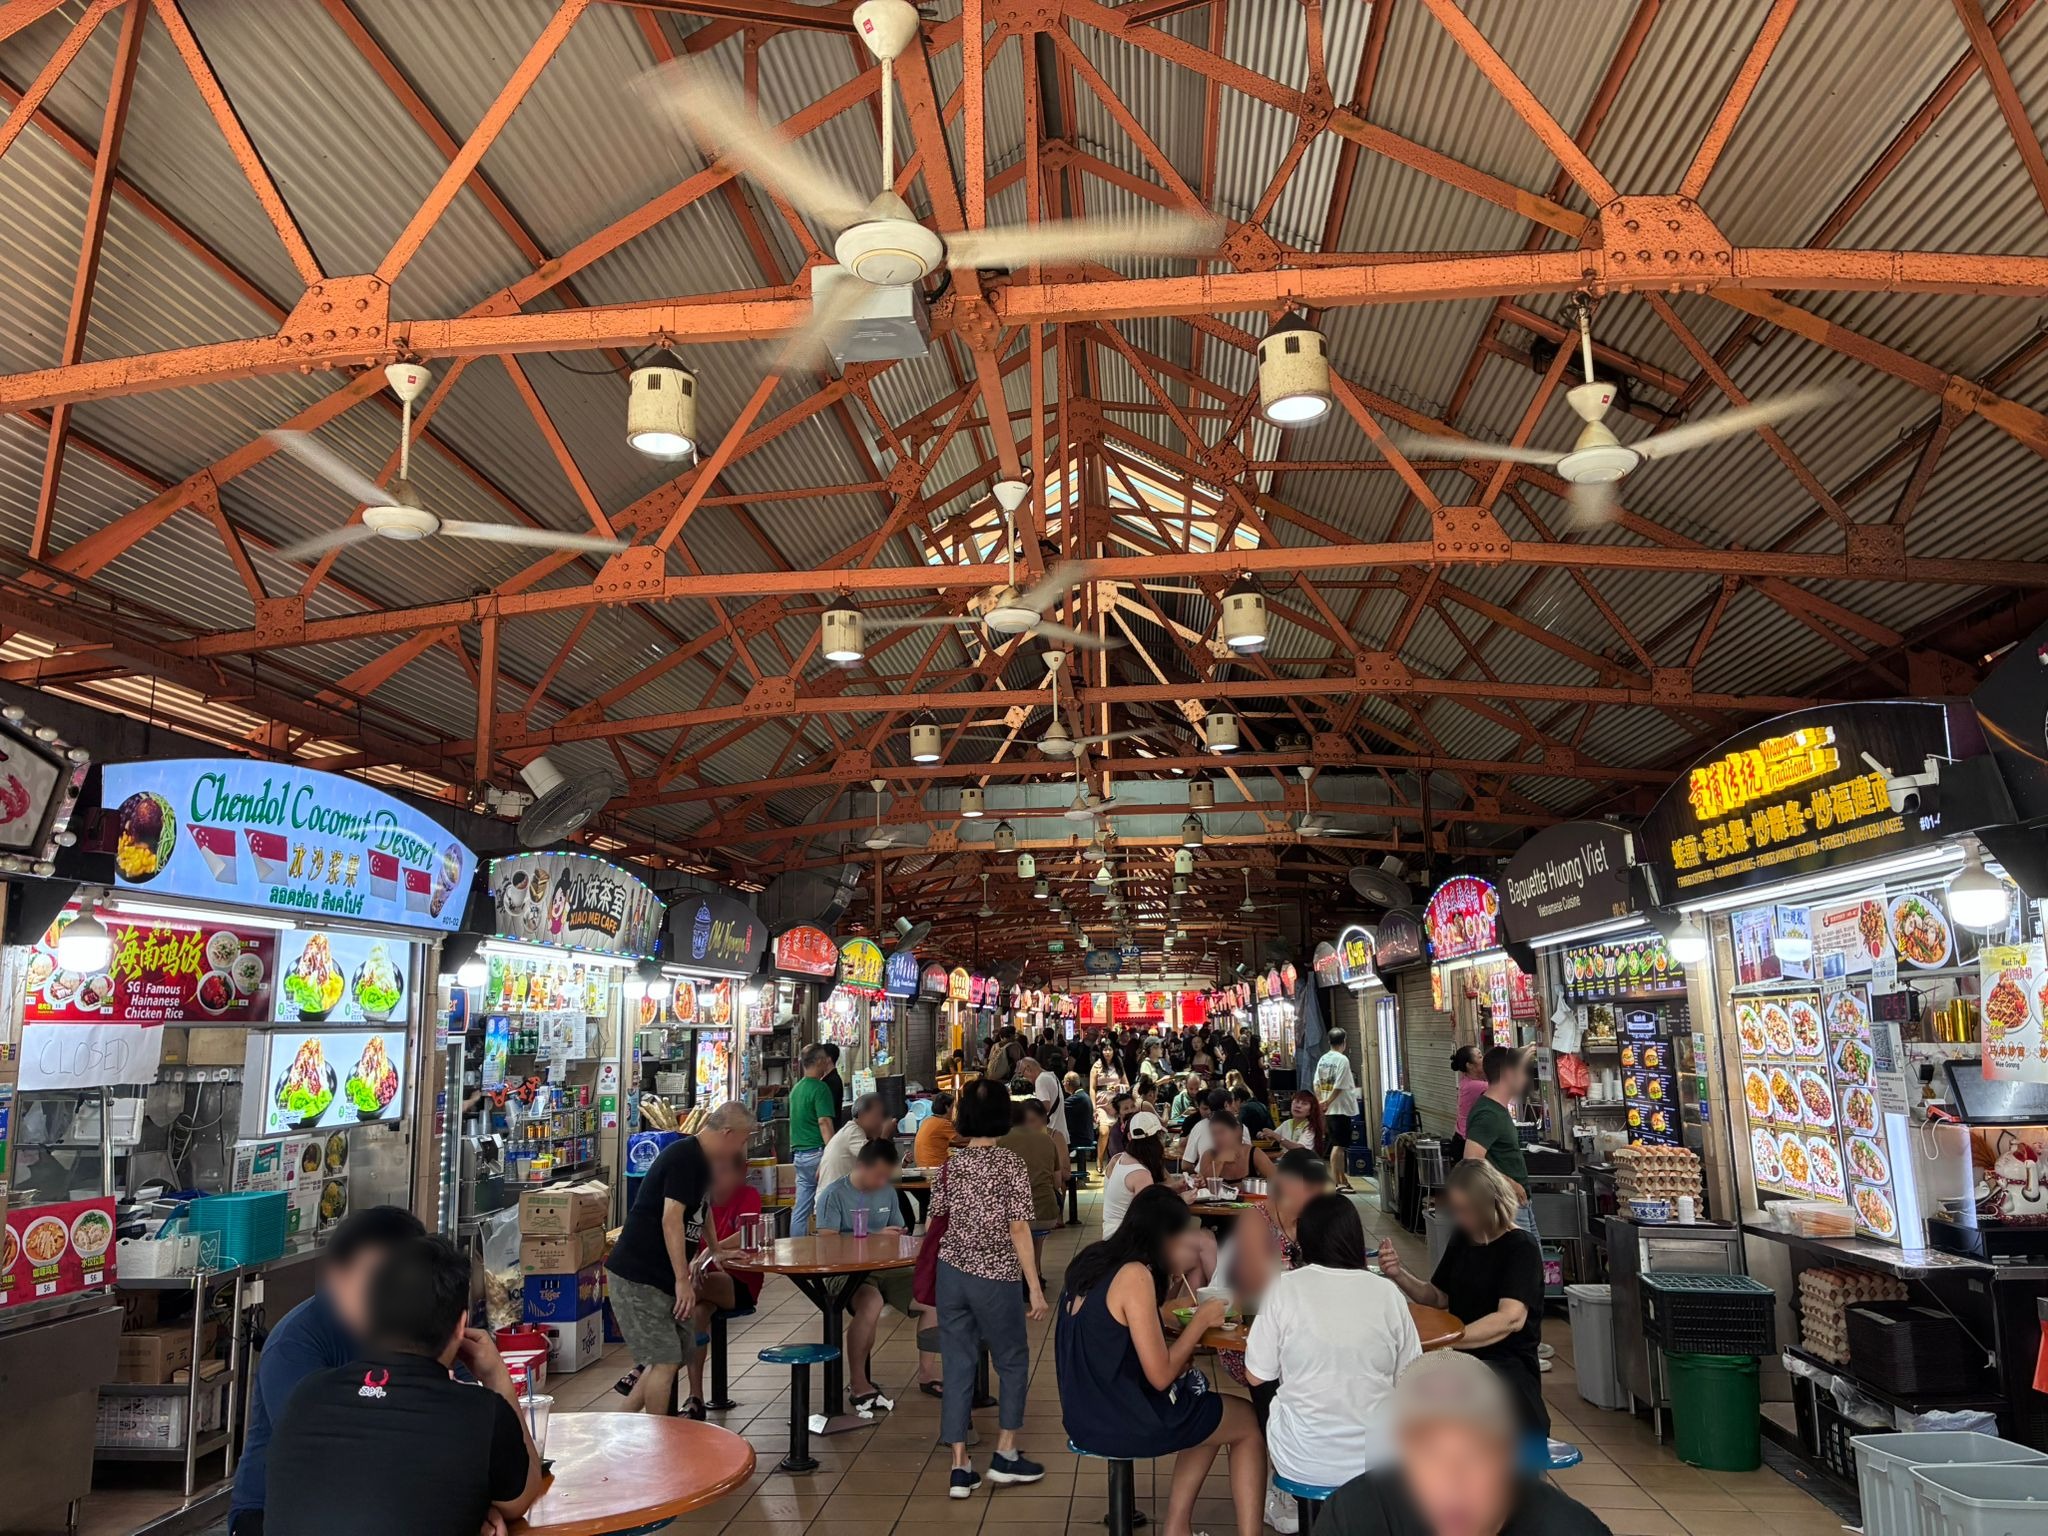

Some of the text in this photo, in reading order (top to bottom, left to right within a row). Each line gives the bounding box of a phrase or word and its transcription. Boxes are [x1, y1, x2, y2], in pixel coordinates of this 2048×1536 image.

[1767, 755, 1814, 788] Traditional
[190, 772, 437, 870] Chendol Coconut Dessert
[1507, 868, 1548, 907] Baguette
[1546, 857, 1584, 889] Huong
[1580, 840, 1609, 876] Viet
[569, 874, 625, 920] 小妹茶室
[1537, 895, 1580, 917] Vietnamese Cuisine
[570, 911, 617, 933] XIAO MEI CAFE
[108, 925, 204, 983] 海南鸡饭
[127, 981, 181, 995] SG Famous
[131, 995, 180, 1006] Hainanese
[125, 1007, 184, 1019] Chicken Rice
[39, 1038, 130, 1077] CLOSED
[540, 1289, 560, 1301] Tiger
[582, 1335, 596, 1354] Tiger
